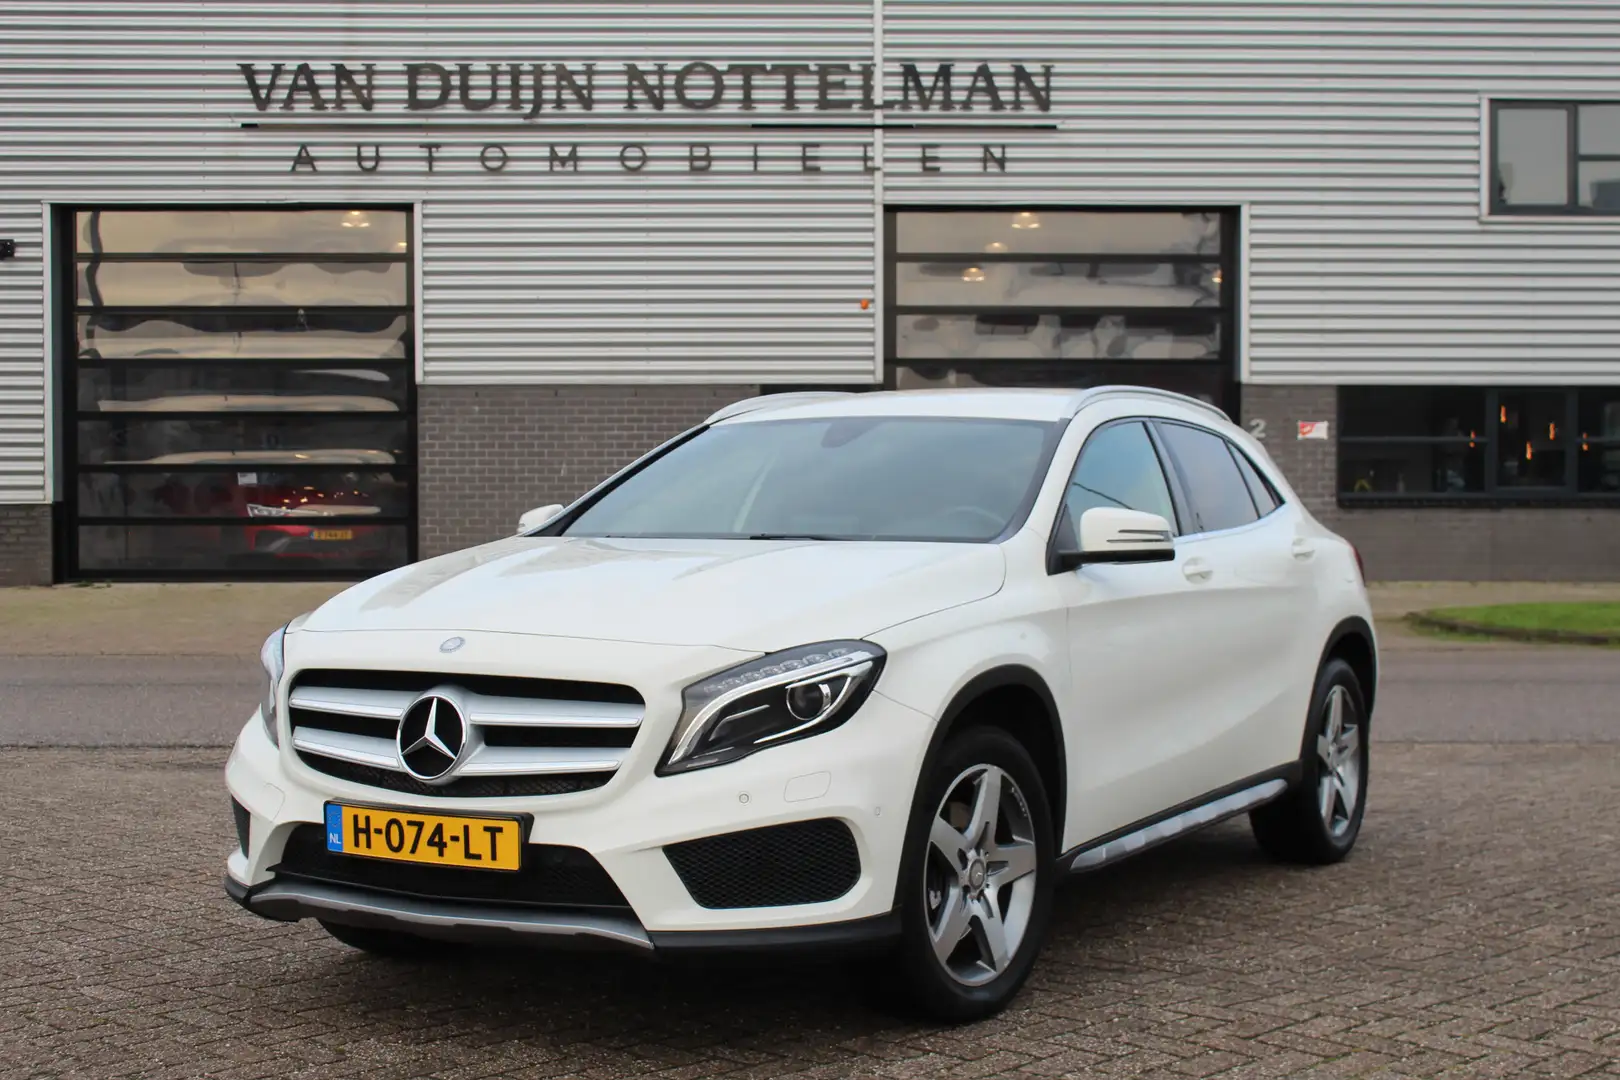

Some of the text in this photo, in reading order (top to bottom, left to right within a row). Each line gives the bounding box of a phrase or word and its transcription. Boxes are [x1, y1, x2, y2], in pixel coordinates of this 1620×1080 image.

[237, 61, 1055, 120] VAN DUIJN NOTTELMAN
[290, 143, 1006, 172] AUTOMOBIELEN
[329, 813, 504, 862] NL H-074-LT
